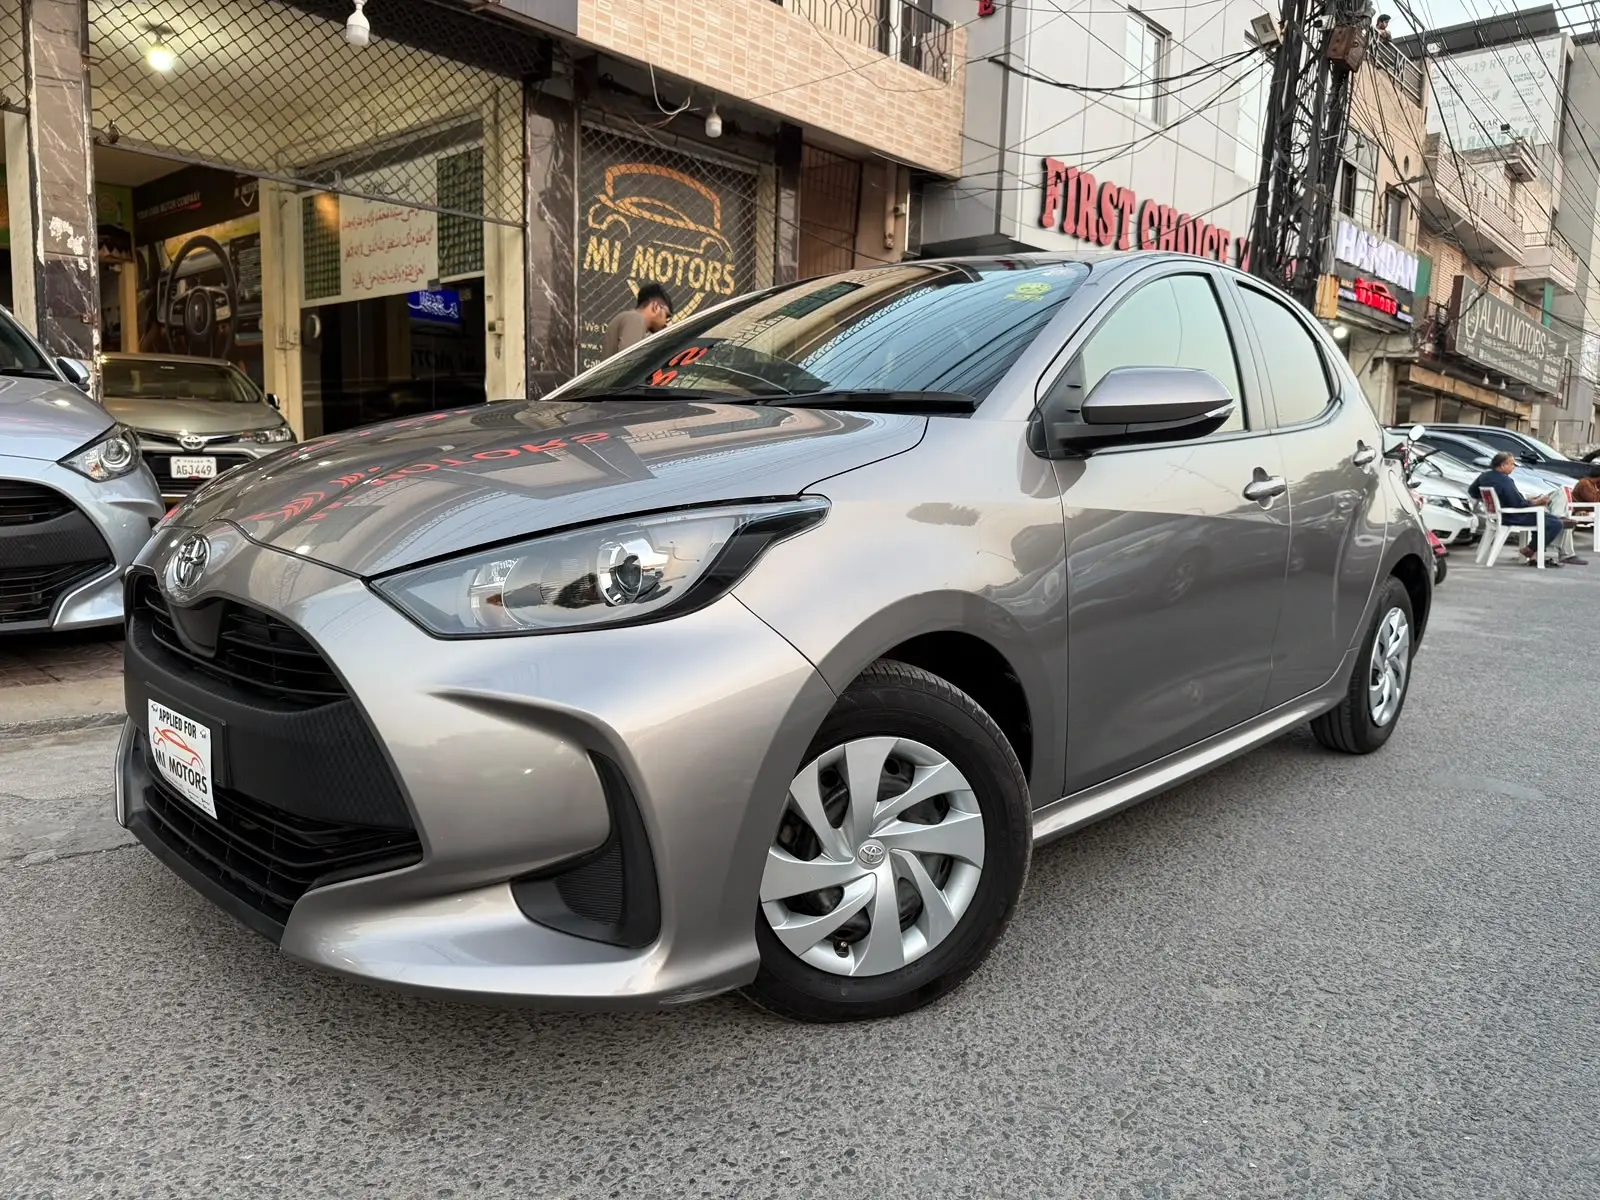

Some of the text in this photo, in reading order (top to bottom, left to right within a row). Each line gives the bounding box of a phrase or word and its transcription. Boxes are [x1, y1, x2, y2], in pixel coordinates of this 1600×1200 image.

[1041, 156, 1136, 251] FIRST
[1139, 198, 1232, 265] CHOICE
[583, 234, 736, 296] MI MOTORS
[1479, 298, 1492, 334] AL
[1492, 305, 1511, 342] ALI
[1510, 313, 1546, 360] MOTORS
[158, 708, 197, 740] APPLIED FOR
[155, 747, 208, 795] MI MOTORS
